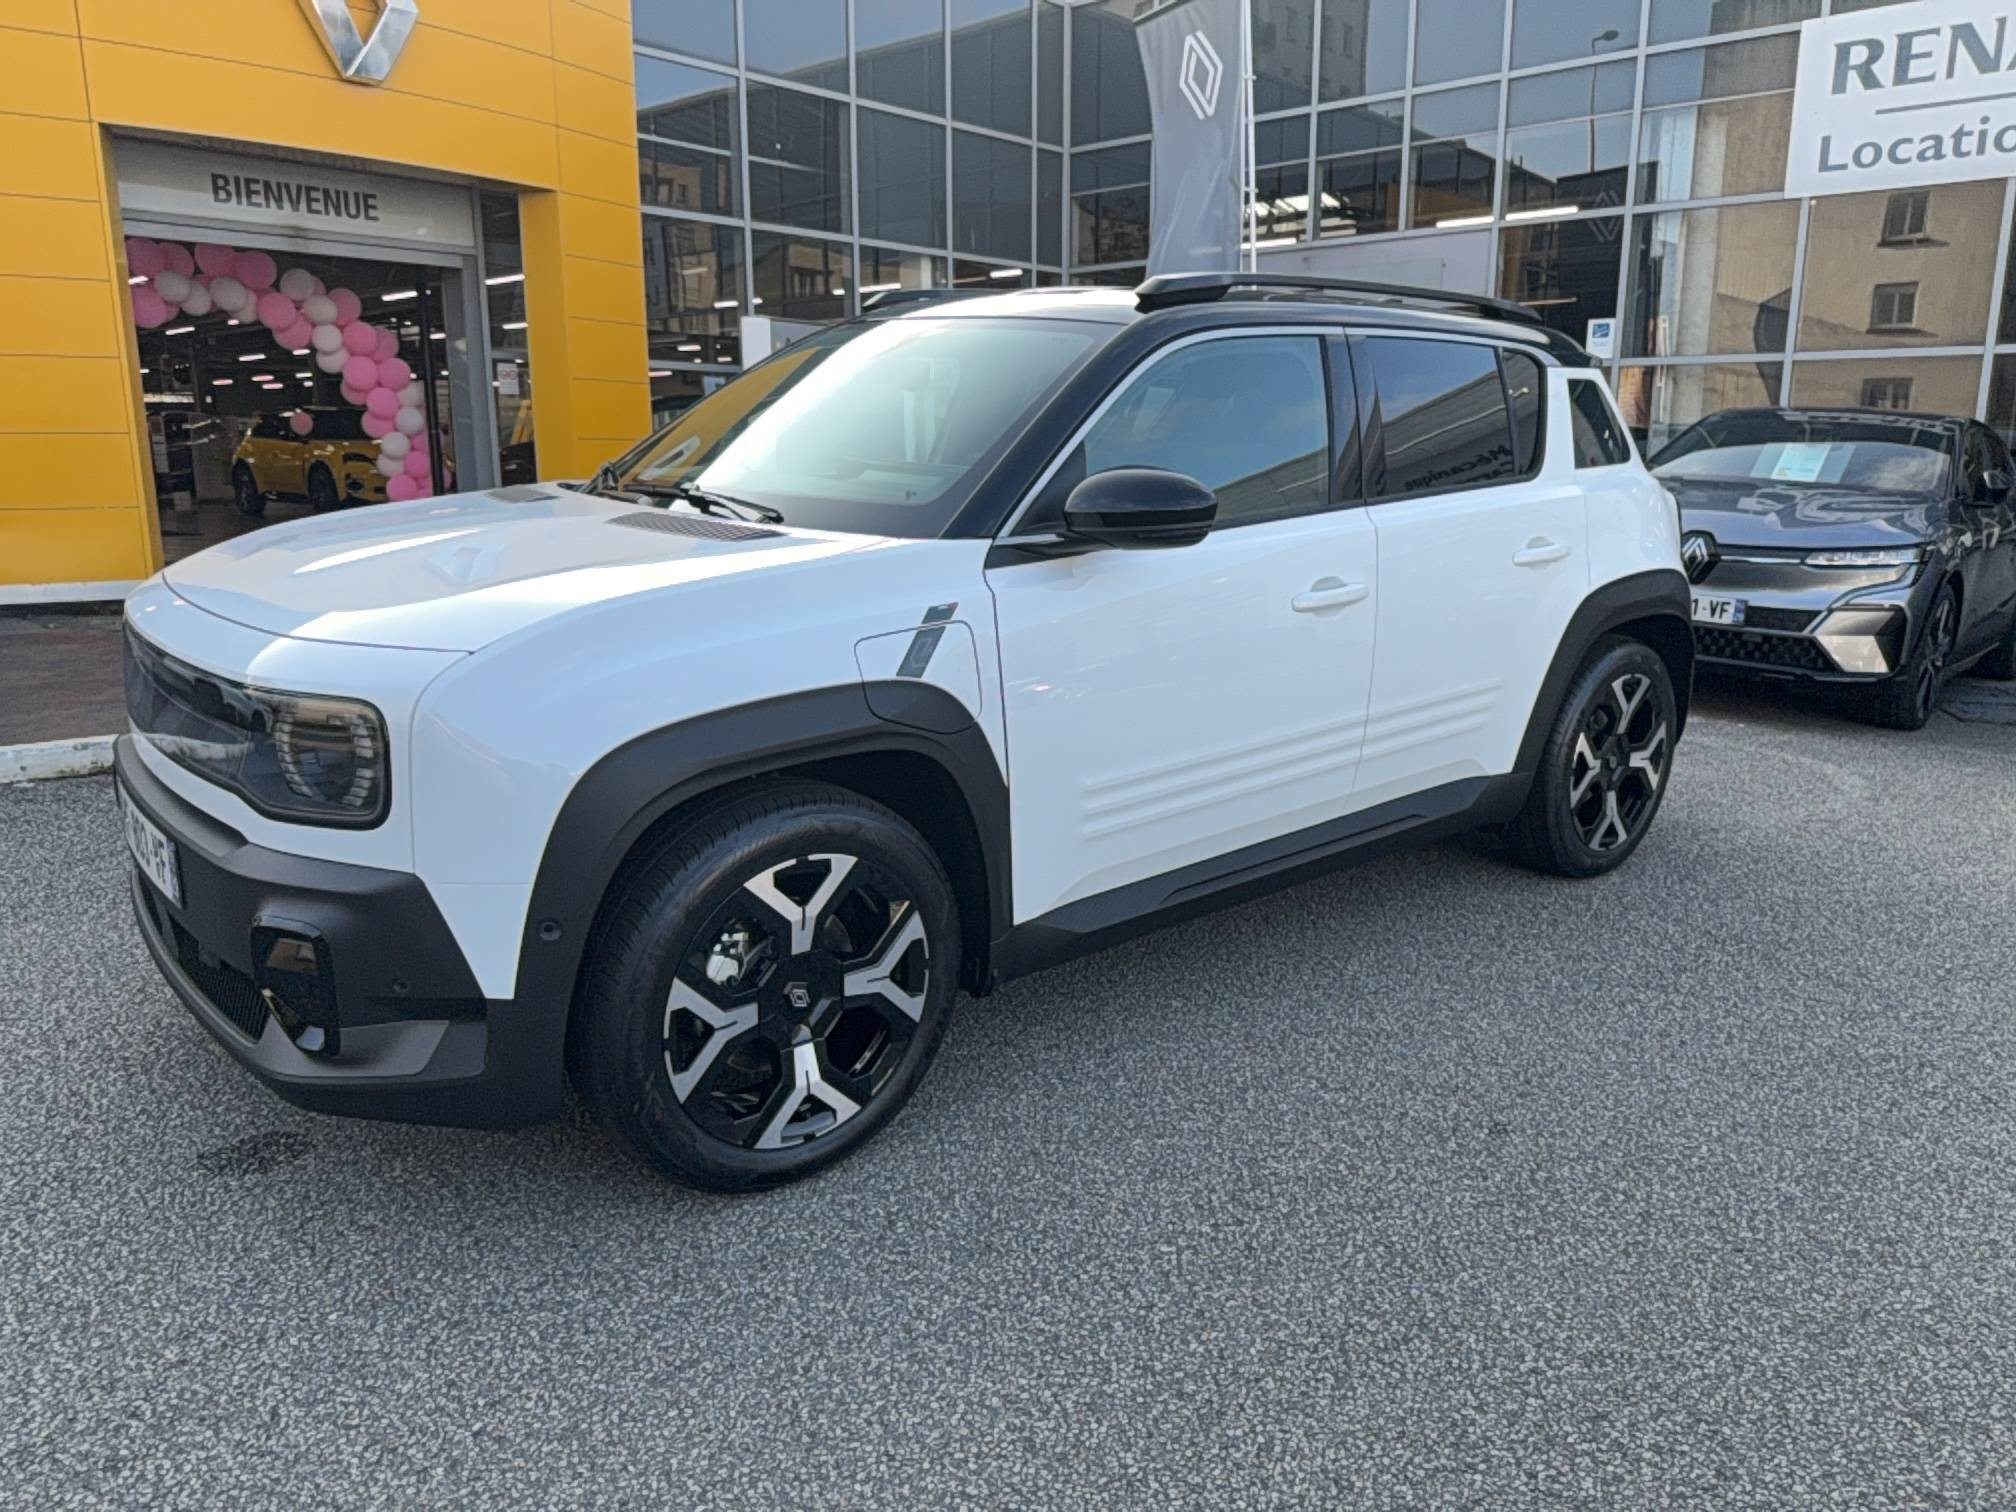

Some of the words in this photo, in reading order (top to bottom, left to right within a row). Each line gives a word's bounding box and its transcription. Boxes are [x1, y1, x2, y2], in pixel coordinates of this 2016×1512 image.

[1831, 16, 2016, 96] REN
[1818, 115, 2016, 173] Locatio
[211, 172, 379, 222] BIENVENUE
